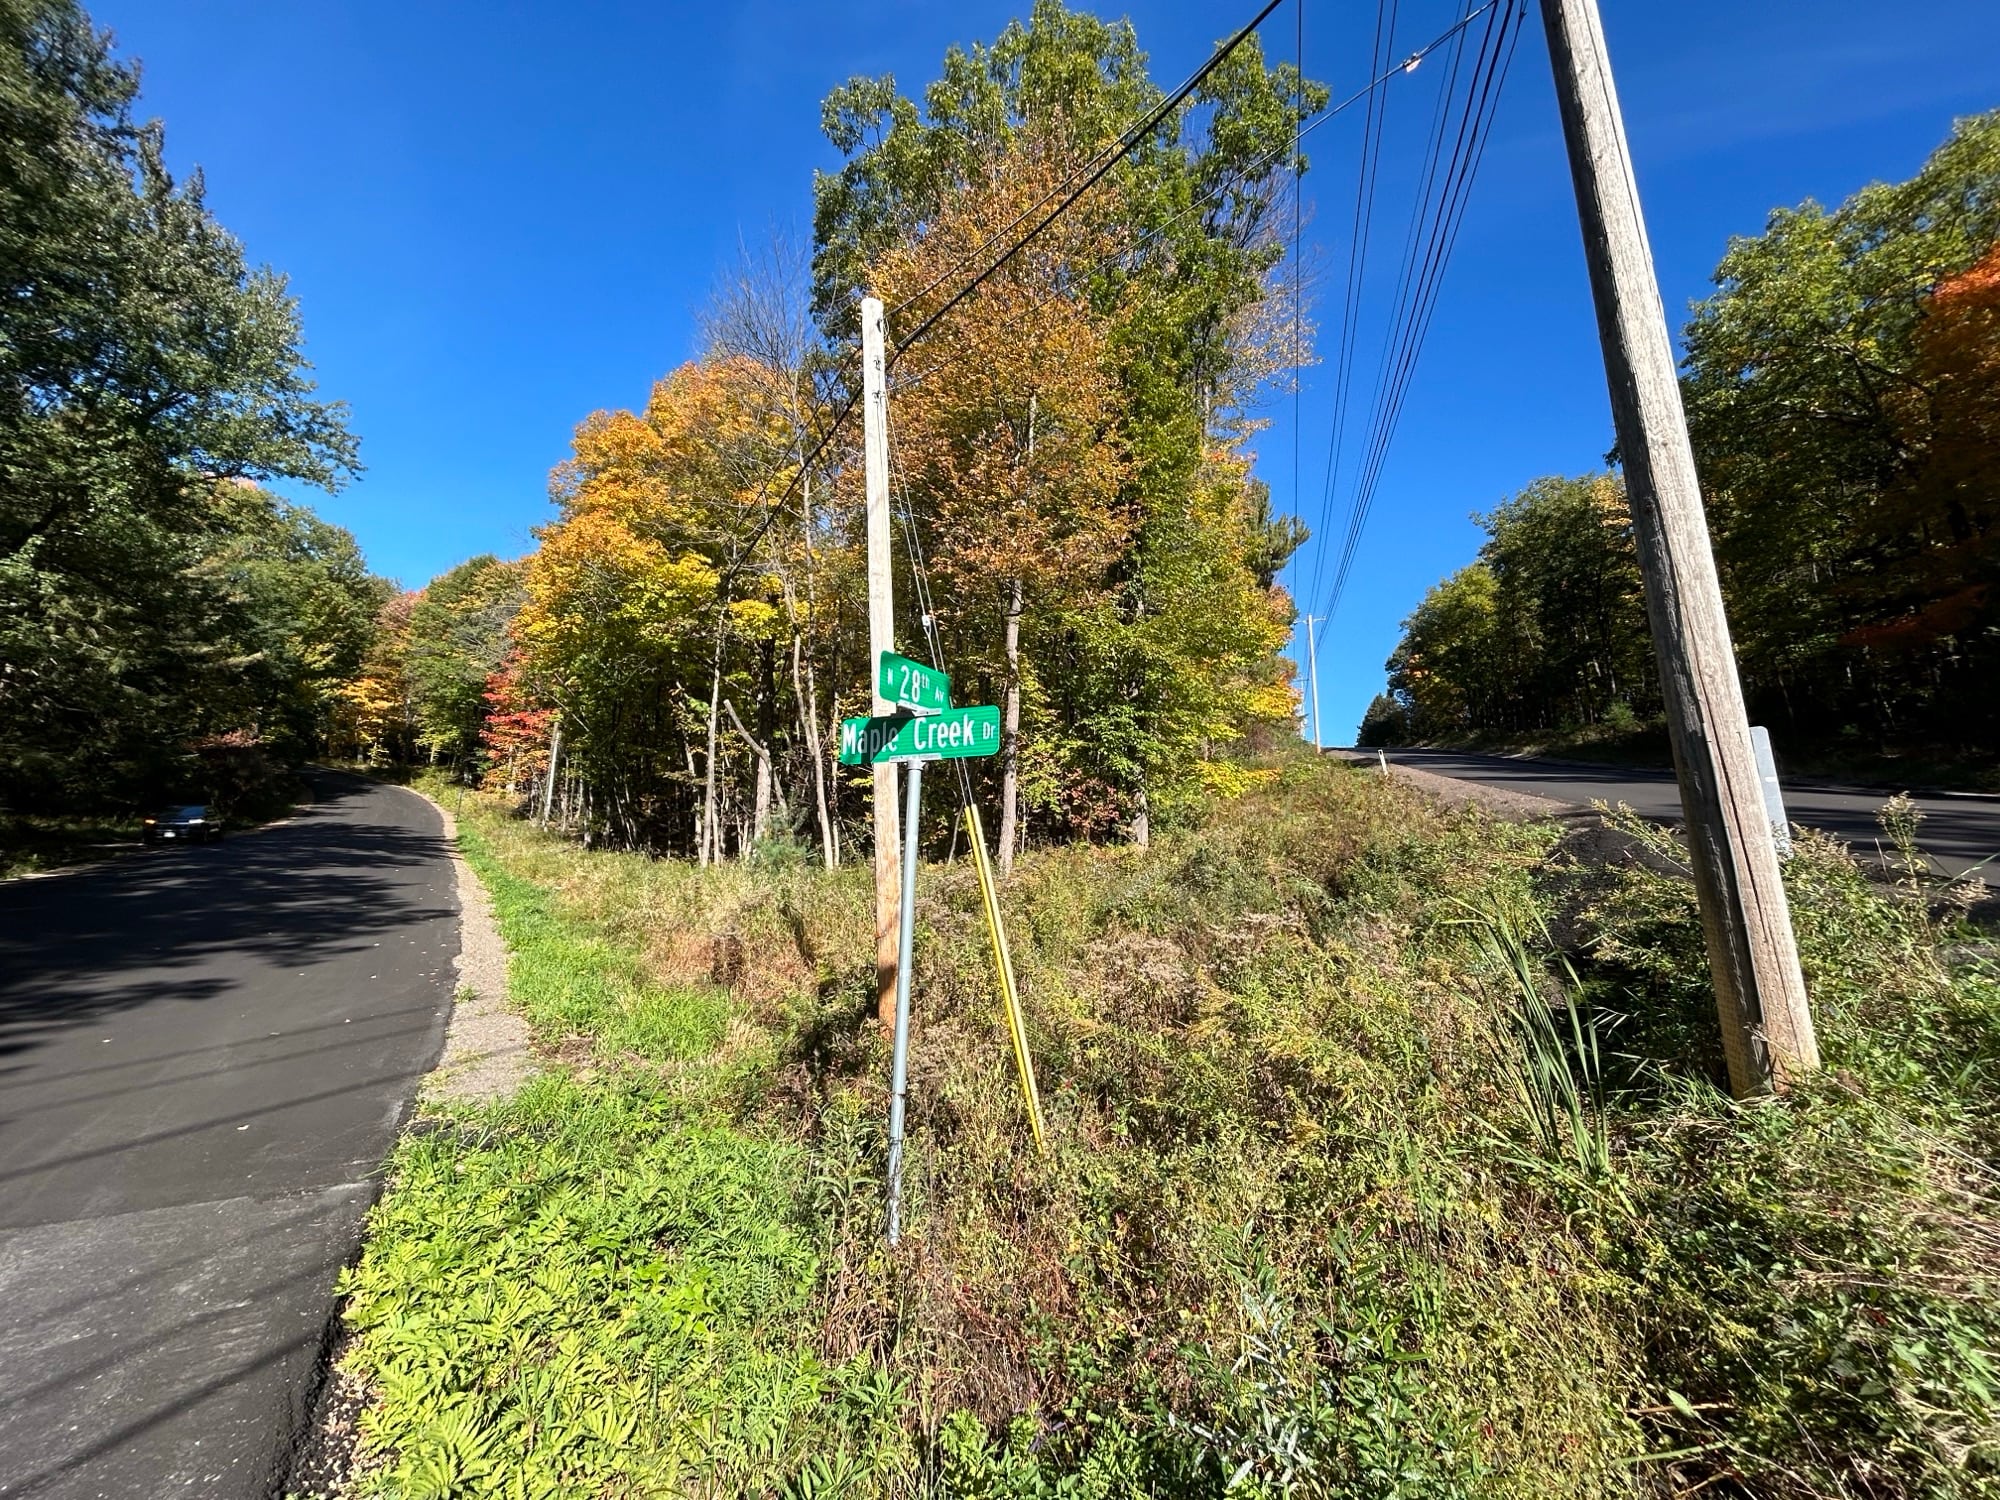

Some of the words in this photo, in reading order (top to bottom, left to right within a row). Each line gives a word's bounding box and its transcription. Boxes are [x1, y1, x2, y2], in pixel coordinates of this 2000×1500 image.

[887, 667, 893, 685] N
[900, 665, 930, 702] 28th
[842, 721, 899, 760] Maple
[914, 713, 975, 750] Creek
[983, 721, 995, 739] Dr
